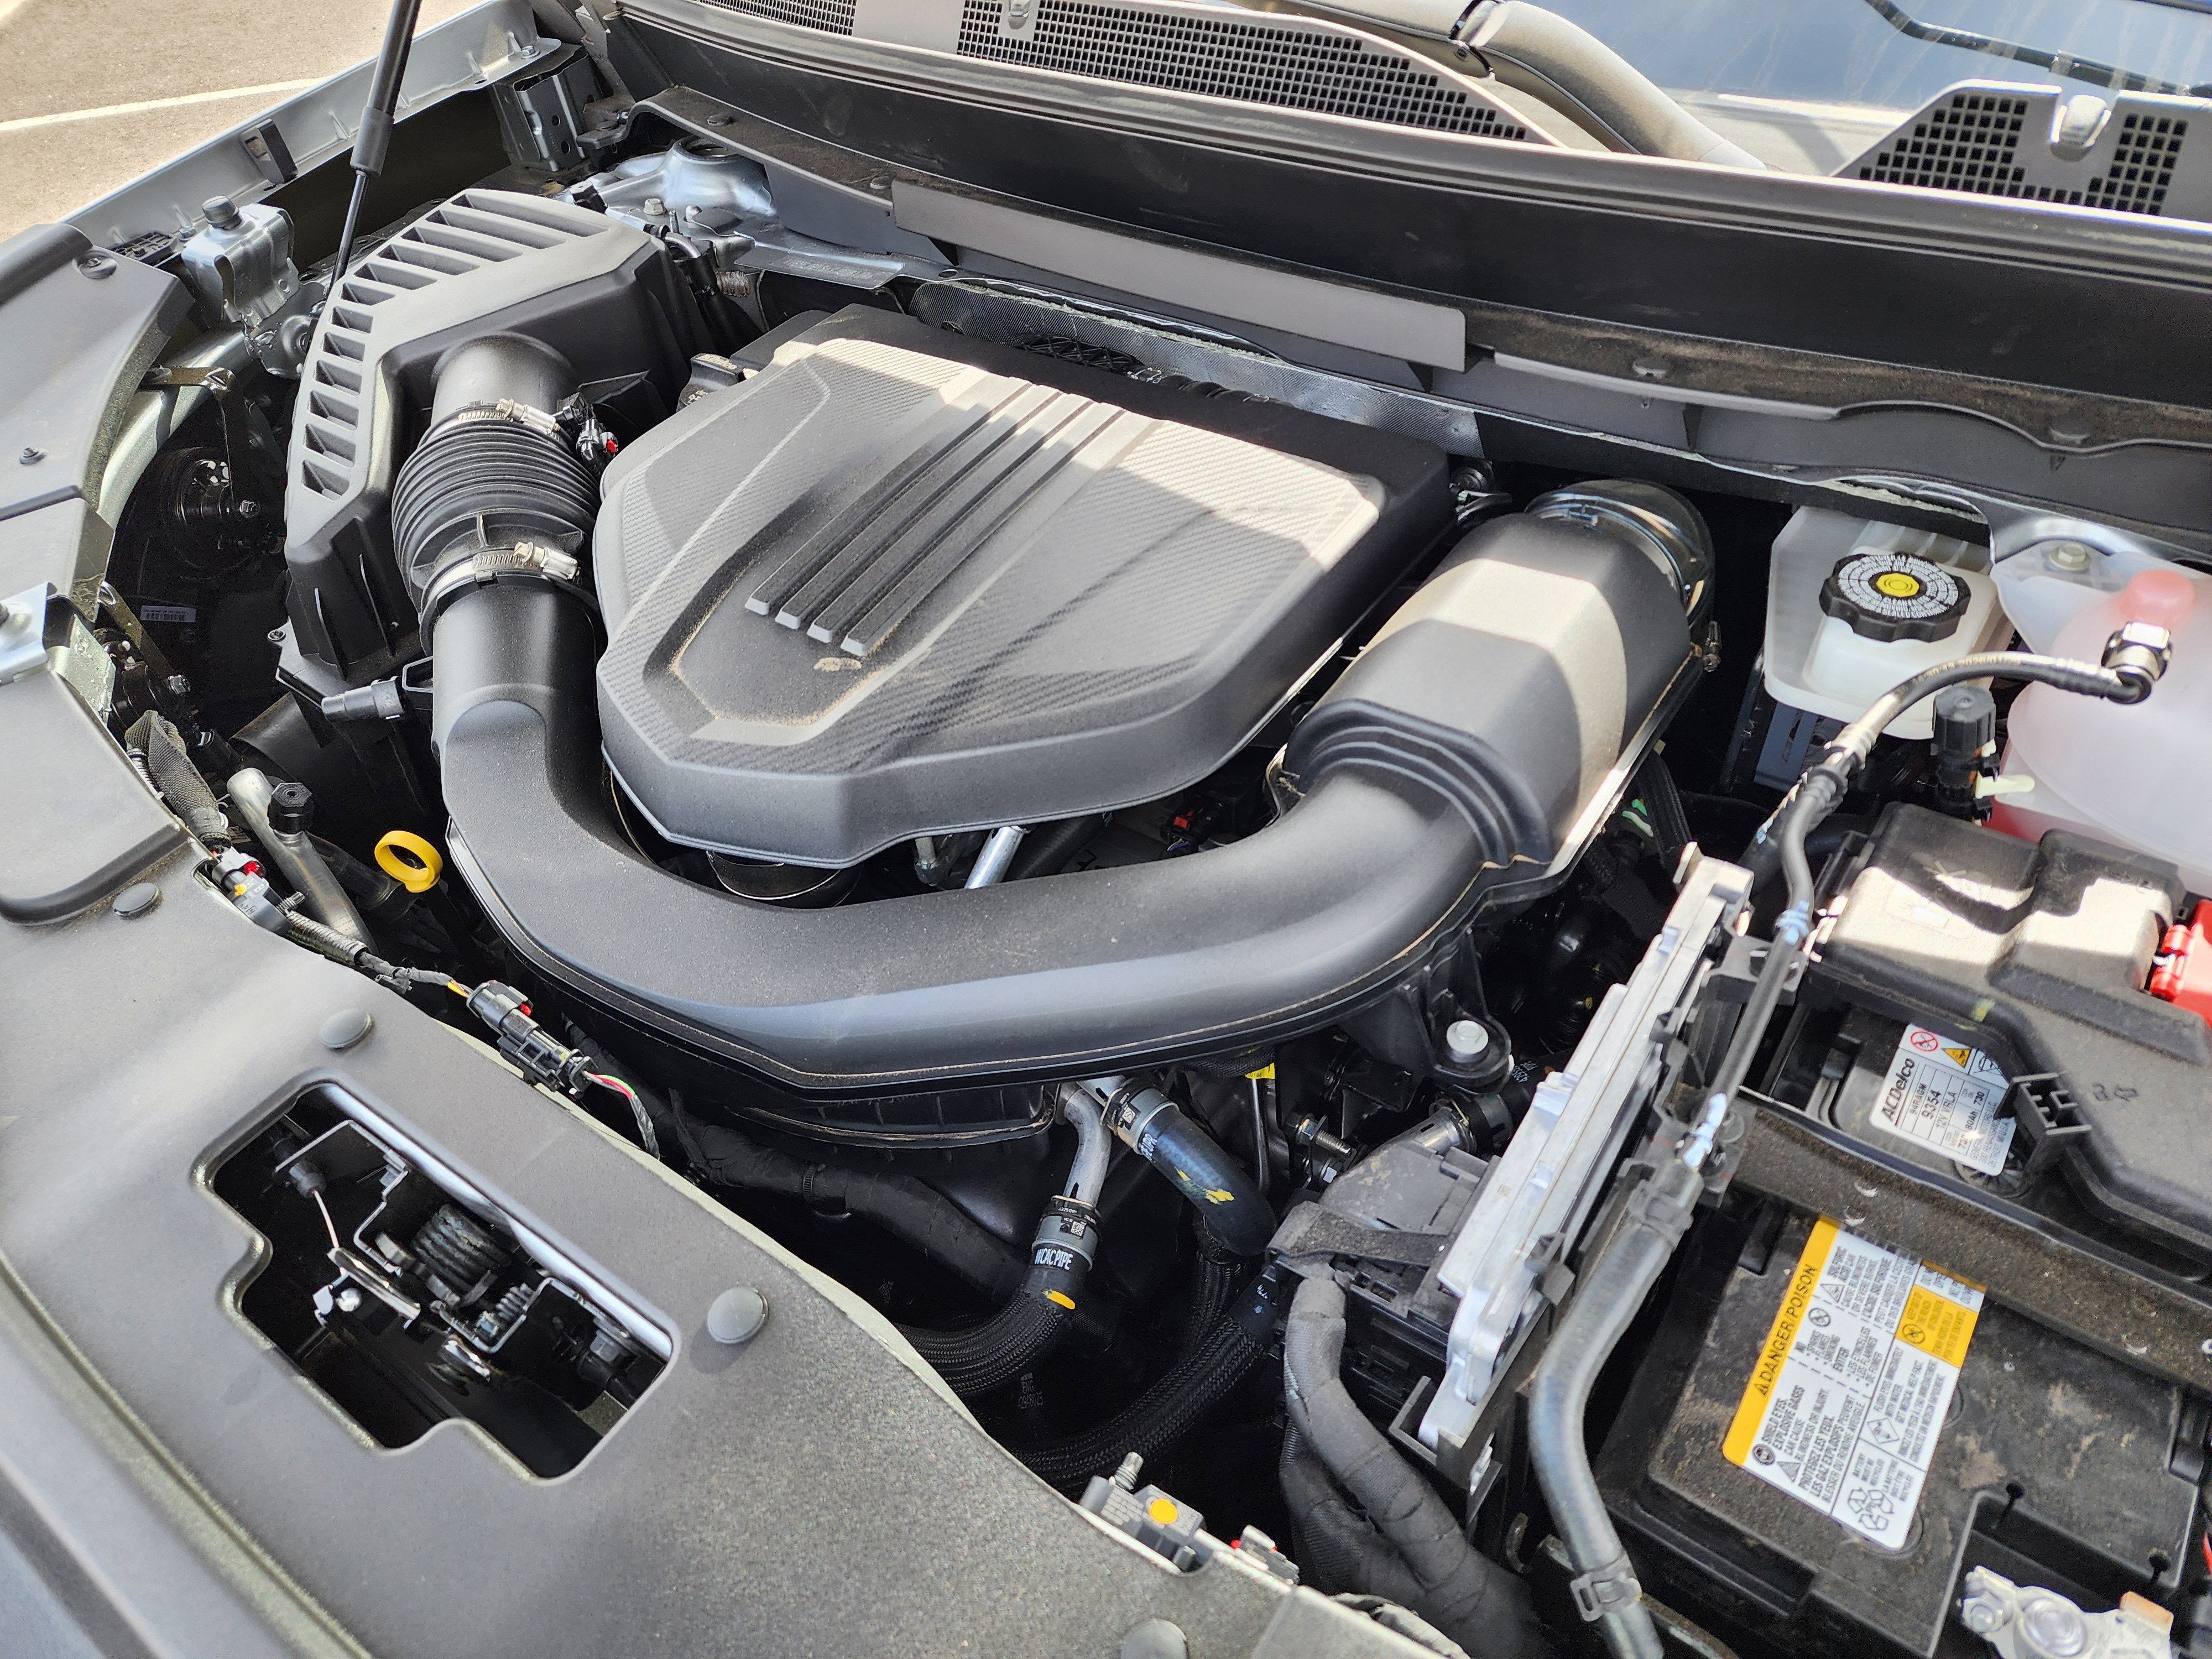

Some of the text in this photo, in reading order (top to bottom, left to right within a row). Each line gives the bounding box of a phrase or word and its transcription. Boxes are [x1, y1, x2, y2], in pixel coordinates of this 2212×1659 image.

[1880, 1057, 1916, 1121] ACDelco
[1909, 1082, 1927, 1114] 94RAGM
[1973, 1091, 1985, 1106] 730
[1921, 1088, 1942, 1119] 9354
[1941, 1090, 1957, 1114] VRLA
[1936, 1114, 1948, 1129] 12V
[1965, 1110, 1977, 1130] 80Ah
[1888, 1274, 1898, 1284] LA
[1759, 1263, 1816, 1383] DANGER/POISON
[1772, 1384, 1804, 1451] EXPLOSIVE GASES
[1808, 1412, 1819, 1424] OR
[1837, 1395, 1855, 1426] PEUVENT
[1813, 1435, 1826, 1452] LES
[1815, 1463, 1829, 1482] GAZ
[1833, 1459, 1844, 1471] OU
[1809, 1480, 1823, 1498] LES
